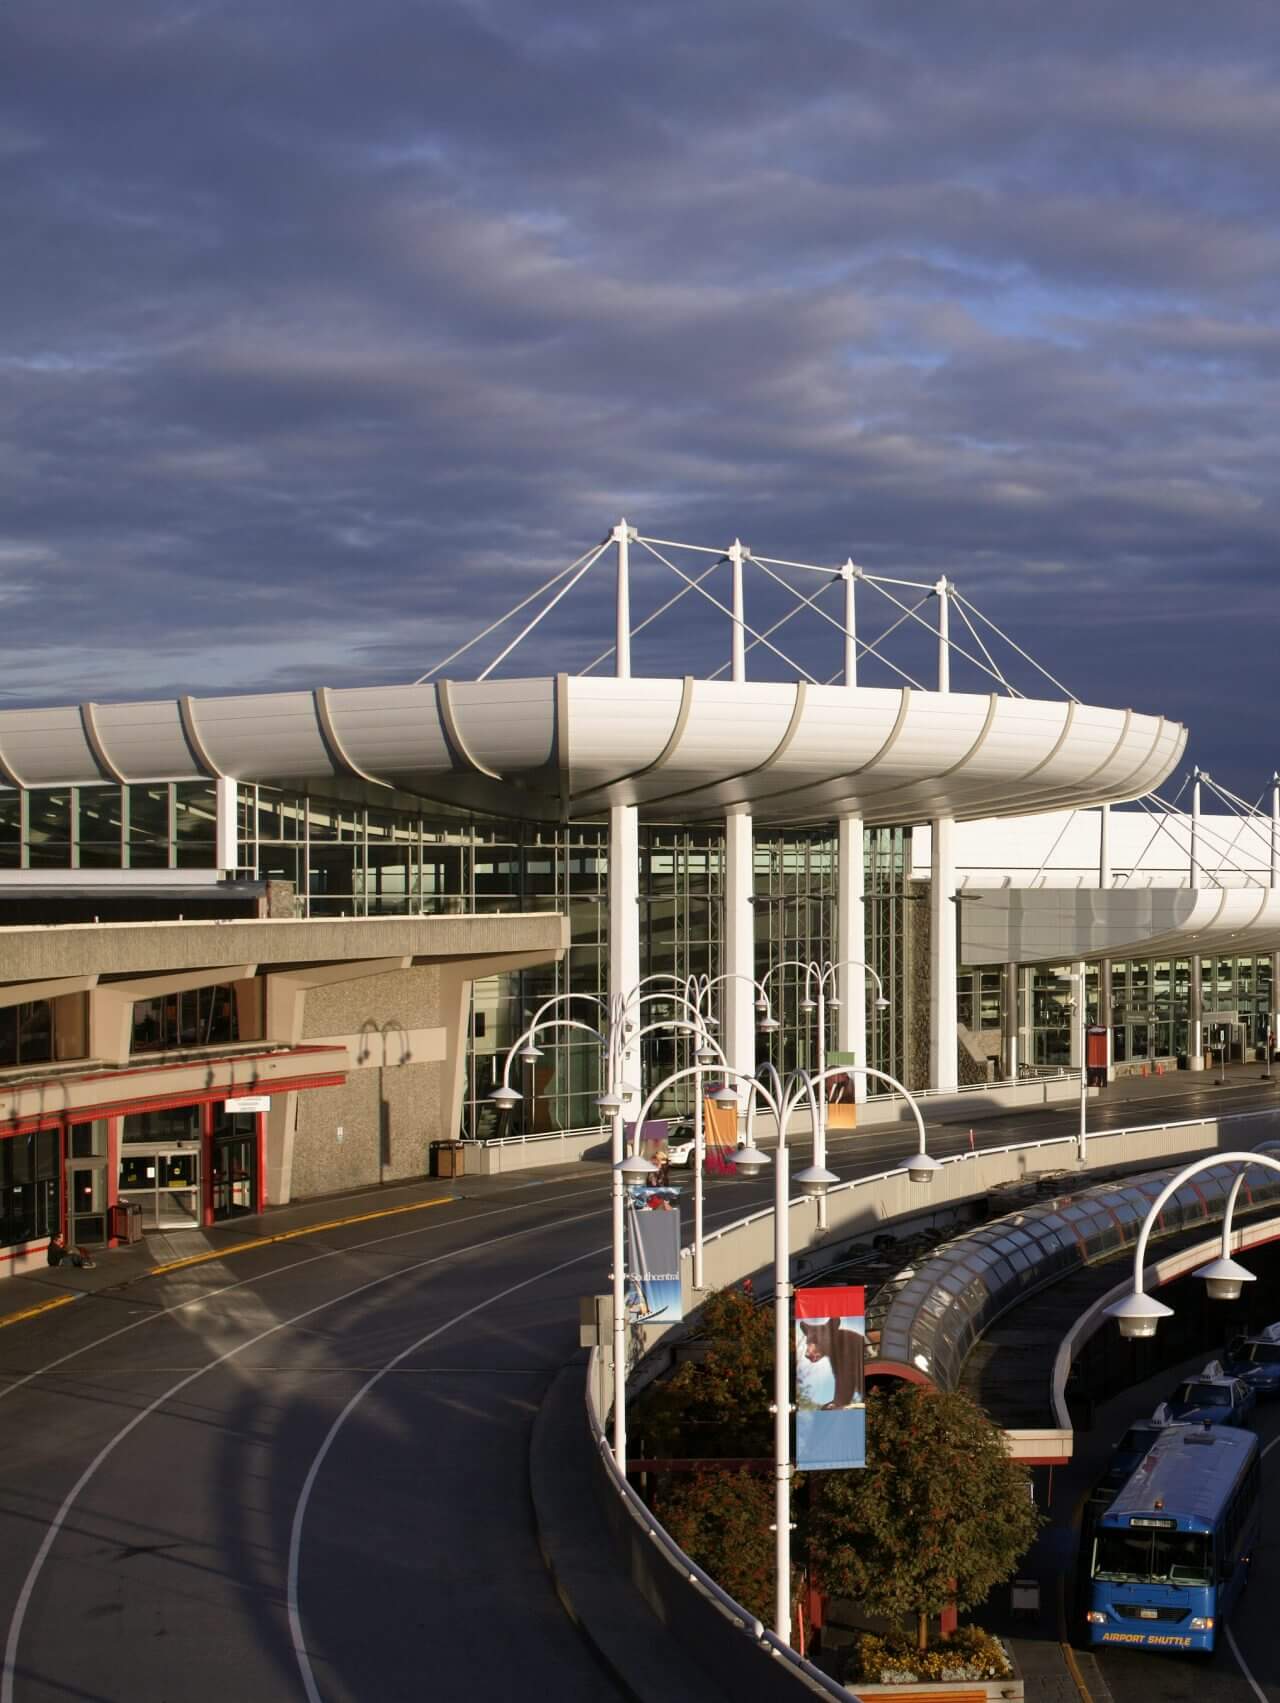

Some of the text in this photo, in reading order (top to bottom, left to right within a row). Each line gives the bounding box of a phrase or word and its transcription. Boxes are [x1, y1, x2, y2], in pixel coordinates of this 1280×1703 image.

[630, 1271, 680, 1281] Sothcentral
[1103, 1632, 1192, 1647] AIRPORT SHUTTLE
